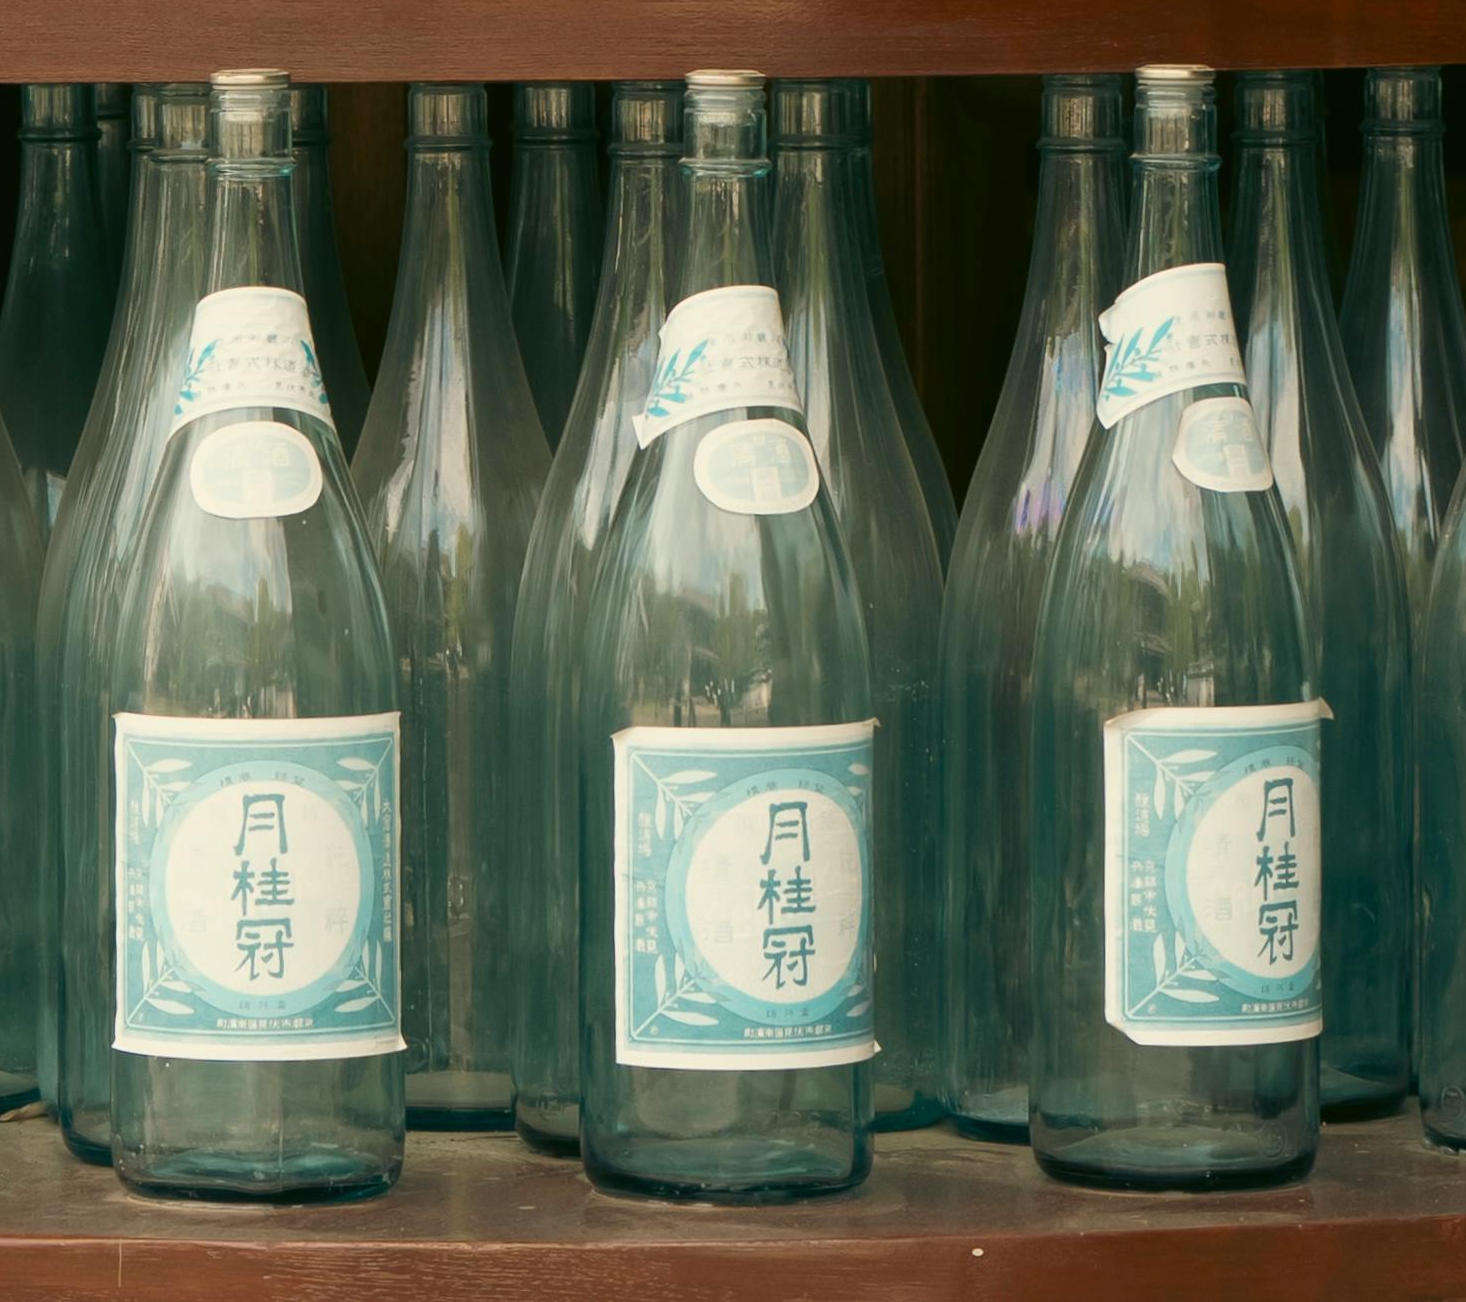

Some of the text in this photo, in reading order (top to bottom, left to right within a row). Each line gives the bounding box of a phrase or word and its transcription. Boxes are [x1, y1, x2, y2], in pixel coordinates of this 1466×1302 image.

[231, 793, 295, 982] 月桂冠
[757, 801, 817, 990] 月桂冠
[1254, 777, 1300, 965] 月桂冠
